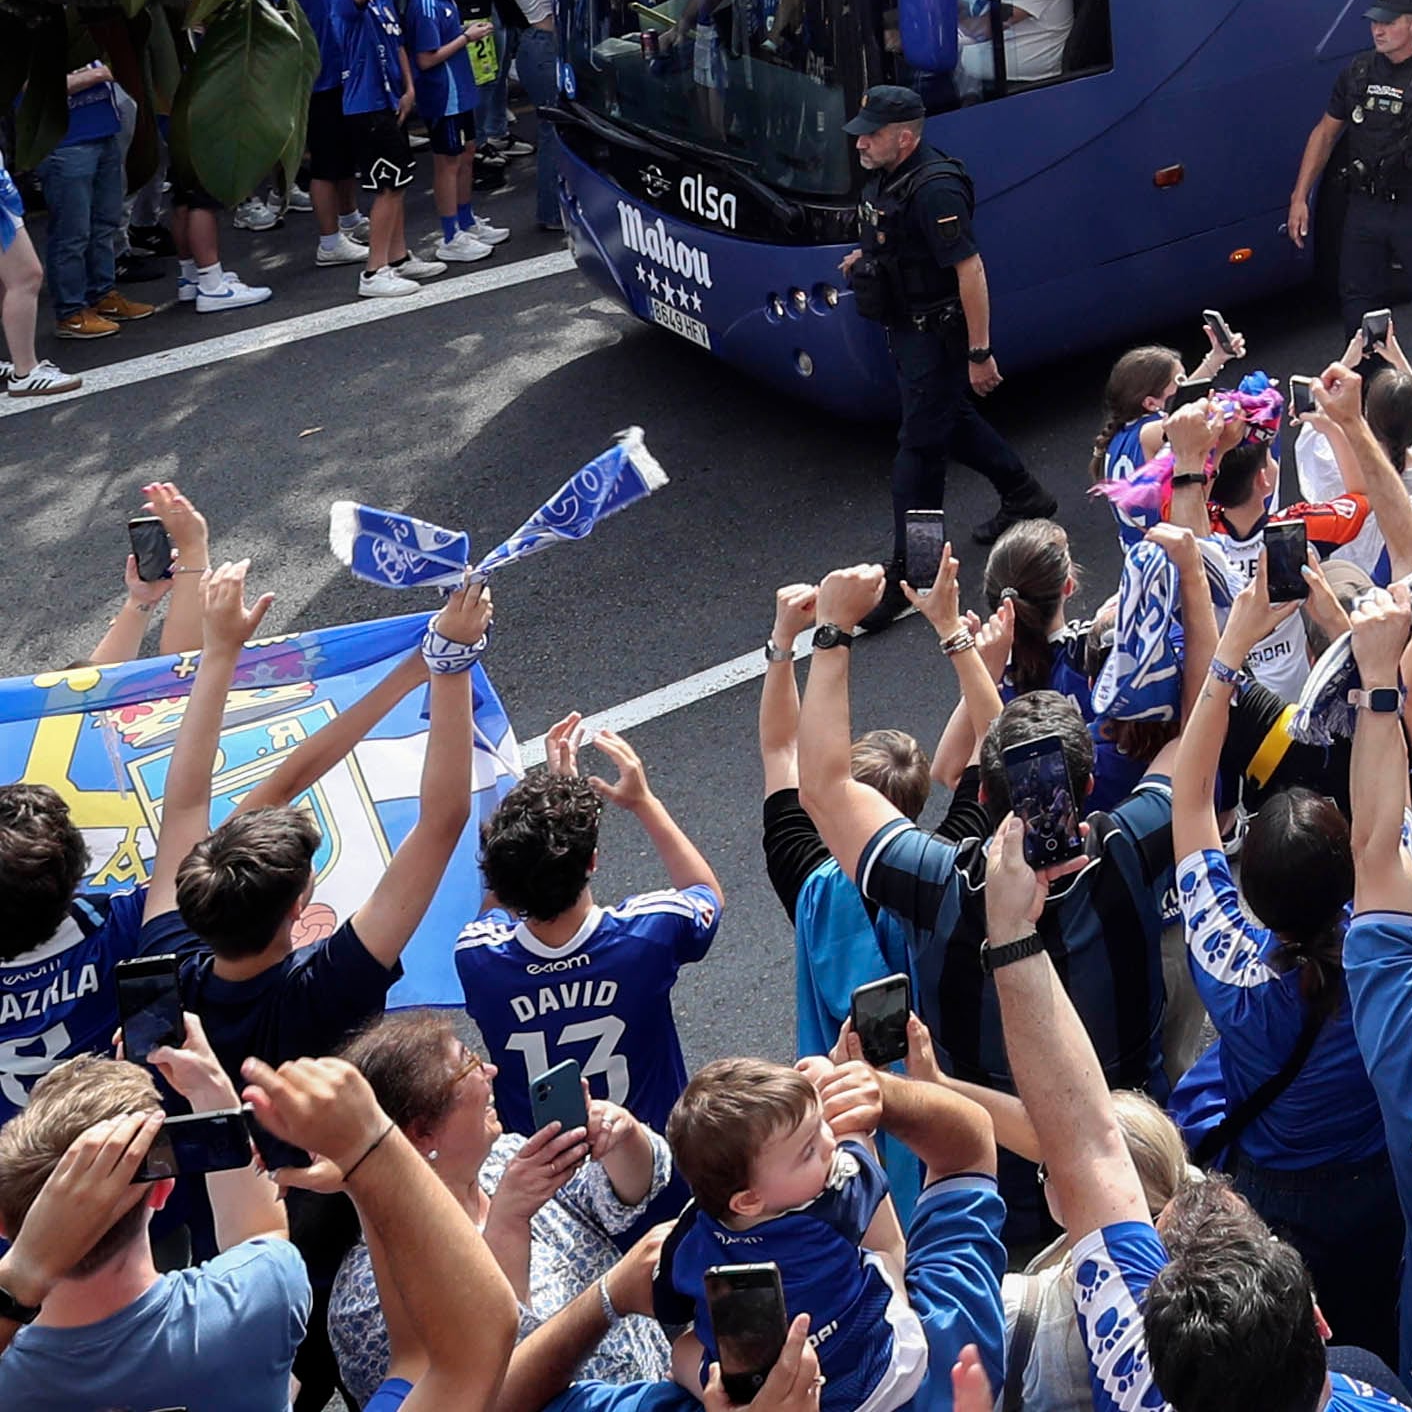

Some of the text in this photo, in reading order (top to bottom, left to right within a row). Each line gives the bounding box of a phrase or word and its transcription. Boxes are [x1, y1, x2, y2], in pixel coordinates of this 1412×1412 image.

[679, 173, 738, 231] alsa
[616, 200, 713, 289] Mahou
[652, 300, 684, 338] 8649
[525, 953, 591, 977] exiom
[510, 980, 620, 1023] DAVID
[505, 1014, 632, 1104] 13
